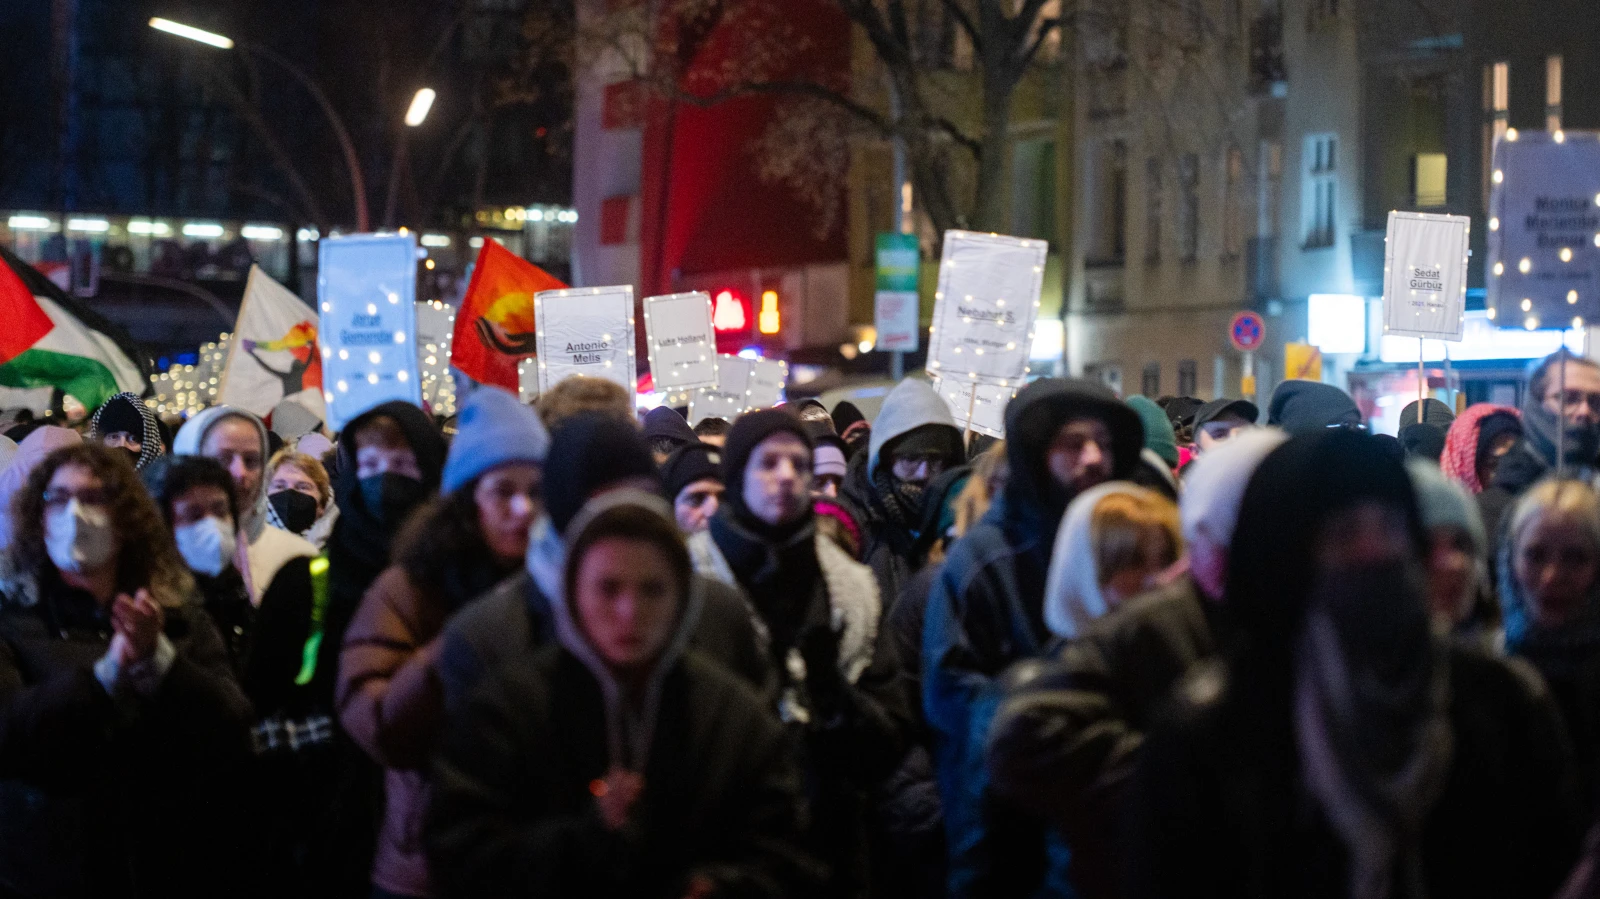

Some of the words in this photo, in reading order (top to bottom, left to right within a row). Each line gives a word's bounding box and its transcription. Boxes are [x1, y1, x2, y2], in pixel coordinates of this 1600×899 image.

[1414, 268, 1440, 278] Sedat
[1410, 279, 1442, 290] Gürbüz
[565, 341, 608, 352] Antonio
[573, 353, 601, 363] Melis
